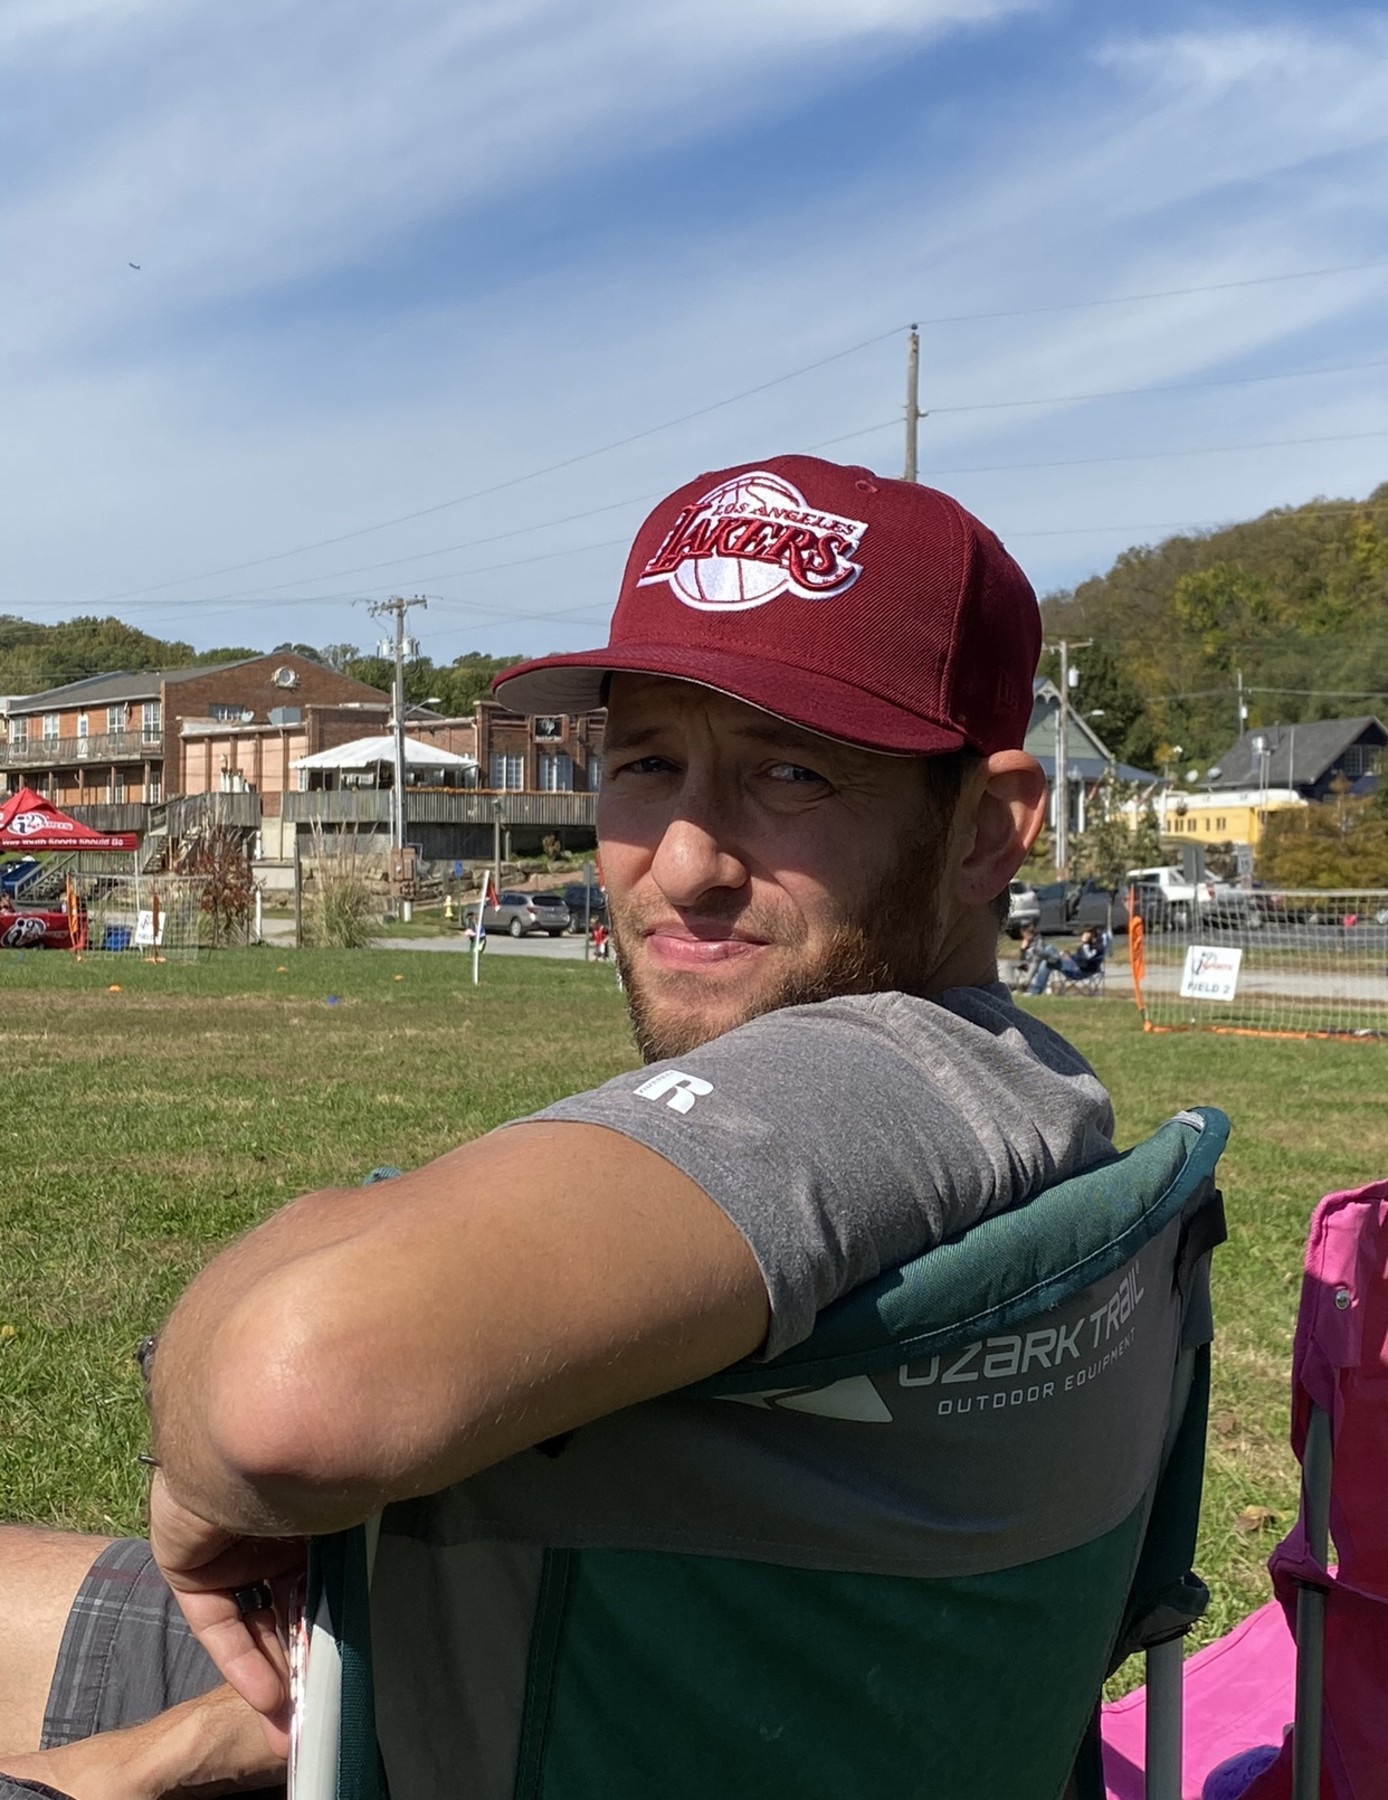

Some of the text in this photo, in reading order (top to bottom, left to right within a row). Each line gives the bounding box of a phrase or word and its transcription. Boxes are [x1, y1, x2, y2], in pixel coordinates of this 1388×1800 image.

[639, 502, 855, 592] LAKERS
[711, 502, 857, 536] LOS ANGELES
[1222, 984, 1231, 995] 2
[937, 1326, 1136, 1416] OUTDOOR EQUIPMENT
